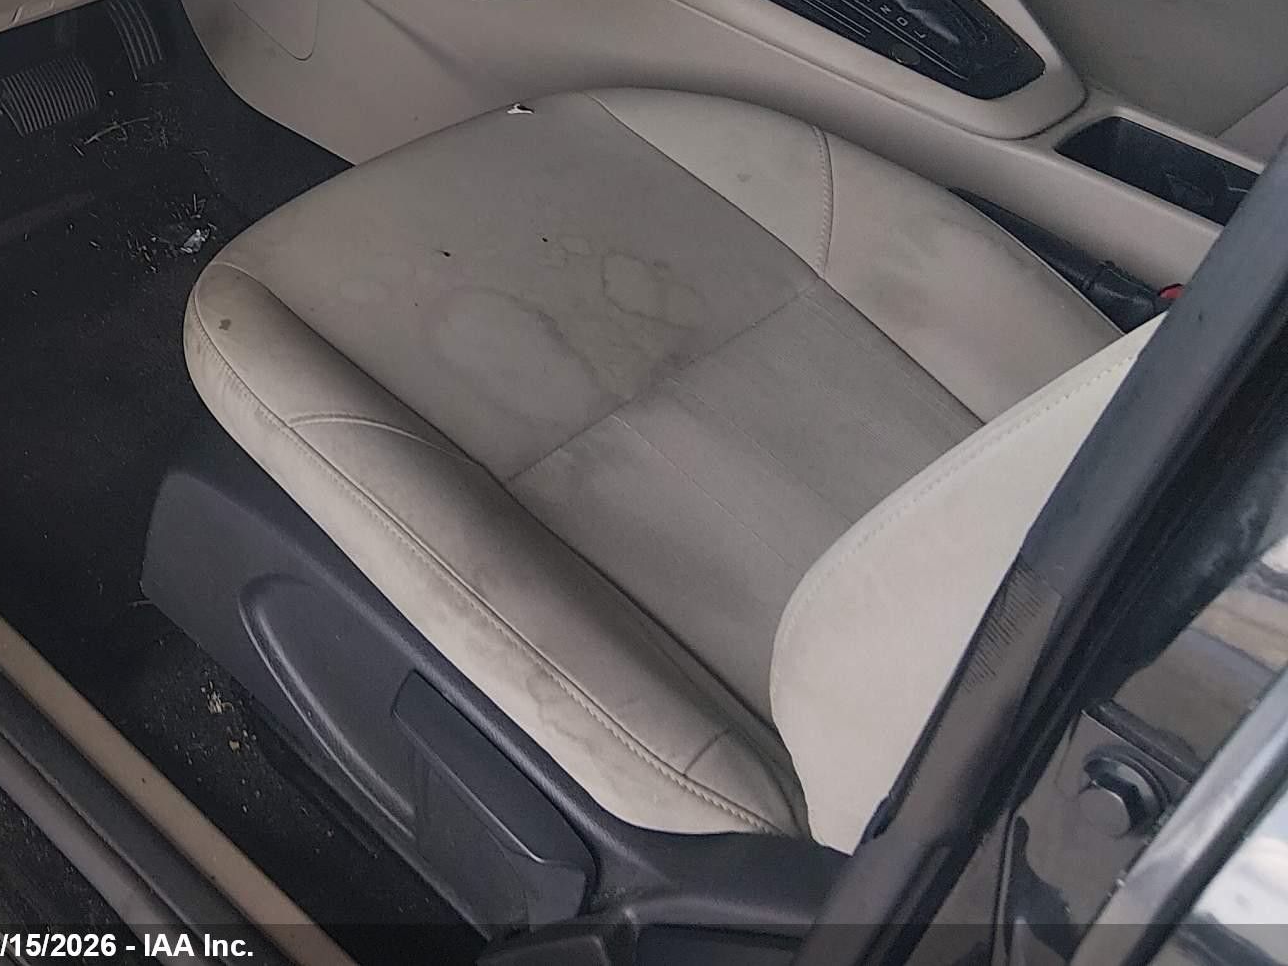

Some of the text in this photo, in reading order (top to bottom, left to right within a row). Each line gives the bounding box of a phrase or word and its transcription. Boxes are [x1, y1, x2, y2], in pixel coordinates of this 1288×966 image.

[879, 4, 892, 14] N
[896, 16, 909, 26] D
[913, 30, 926, 38] L
